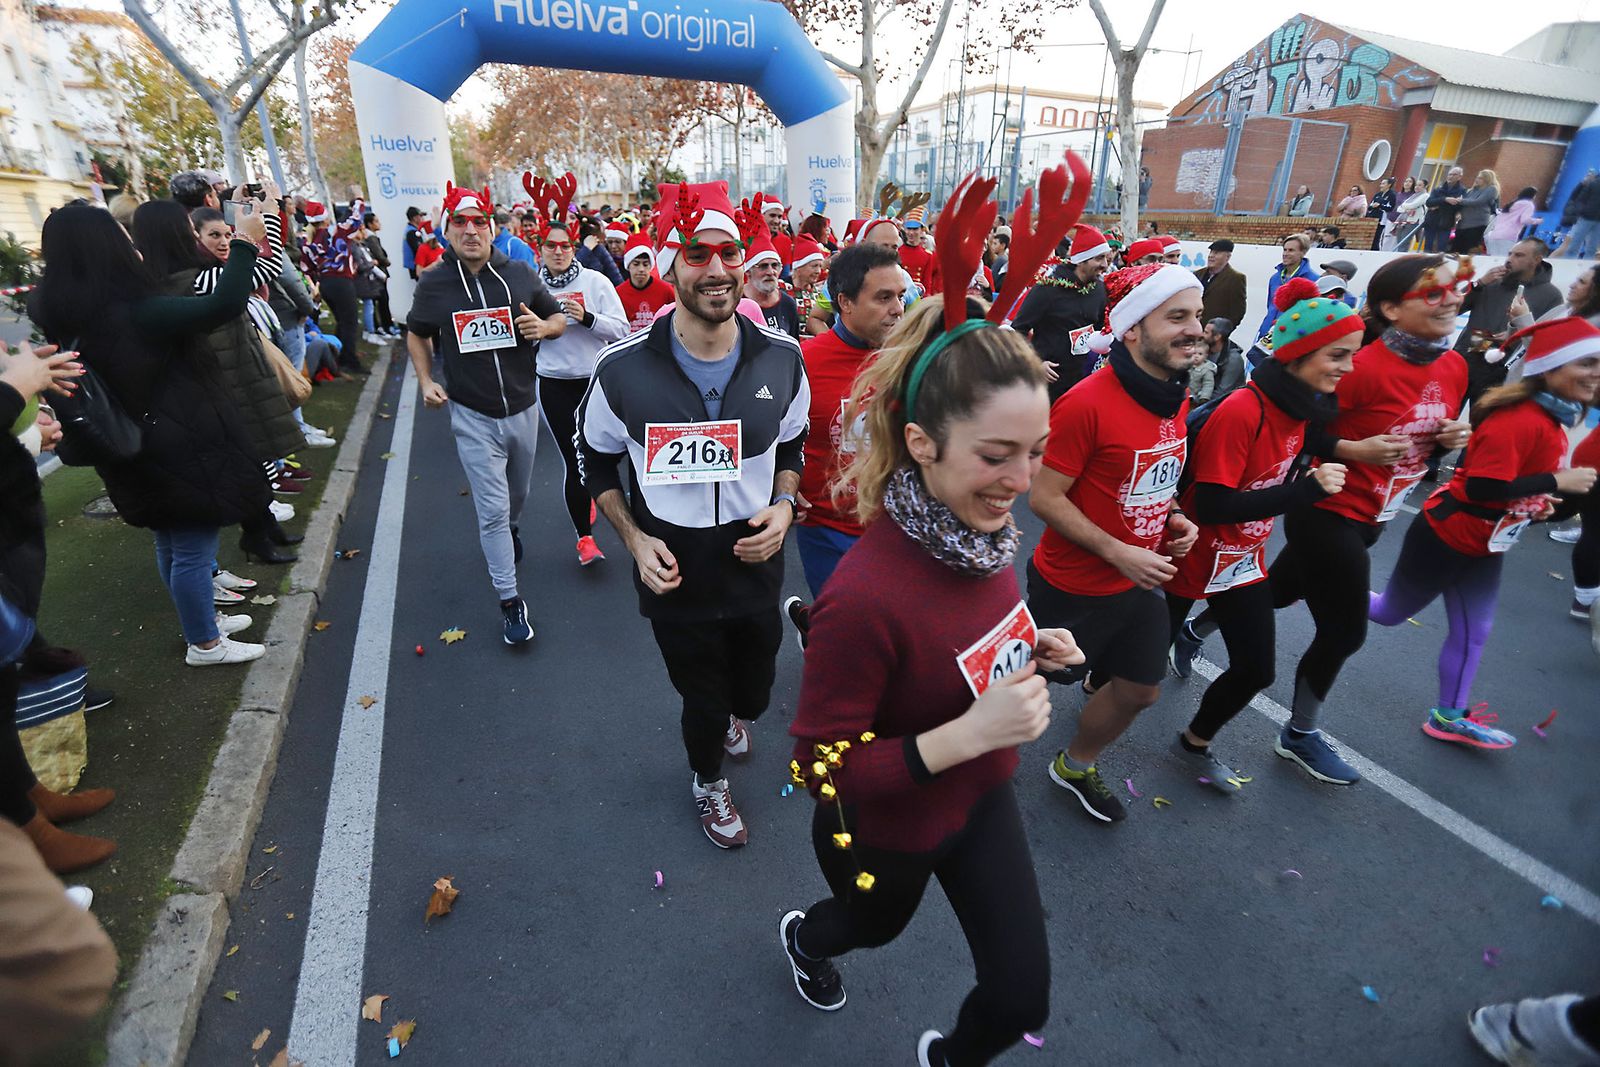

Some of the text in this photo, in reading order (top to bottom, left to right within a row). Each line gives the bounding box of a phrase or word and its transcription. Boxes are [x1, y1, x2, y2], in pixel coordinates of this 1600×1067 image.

[494, 0, 756, 51] Huelva original
[370, 134, 434, 153] Huelva
[400, 186, 439, 195] HUELVA
[469, 319, 499, 338] 215
[668, 440, 717, 465] 216
[1151, 458, 1177, 487] 181
